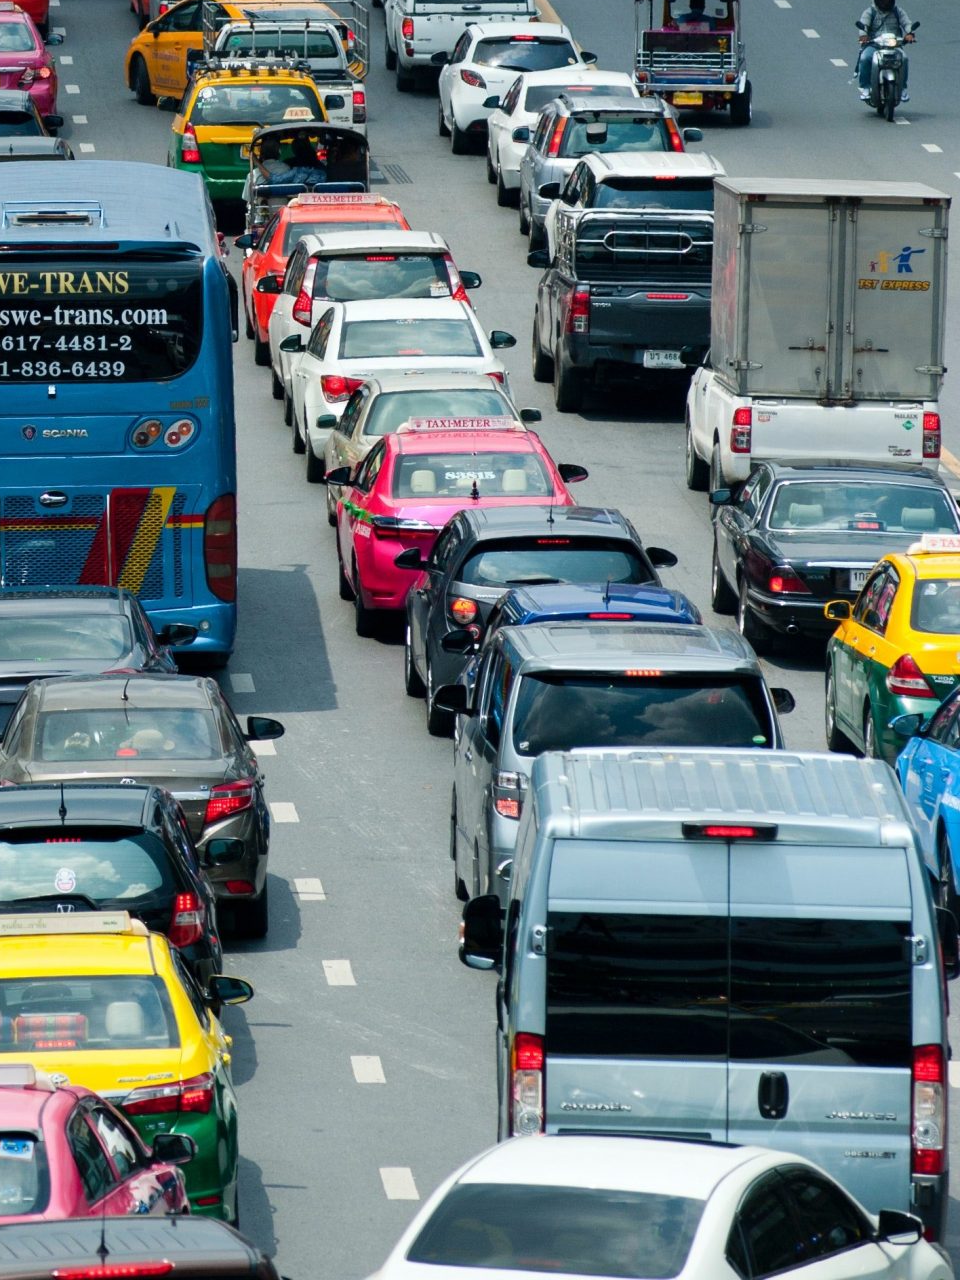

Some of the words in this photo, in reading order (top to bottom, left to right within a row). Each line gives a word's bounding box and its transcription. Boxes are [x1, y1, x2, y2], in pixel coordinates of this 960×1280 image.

[857, 278, 878, 290] TST
[880, 279, 931, 292] EXPRESS
[425, 419, 491, 428] TAXI-METER
[42, 428, 89, 439] SCANIA
